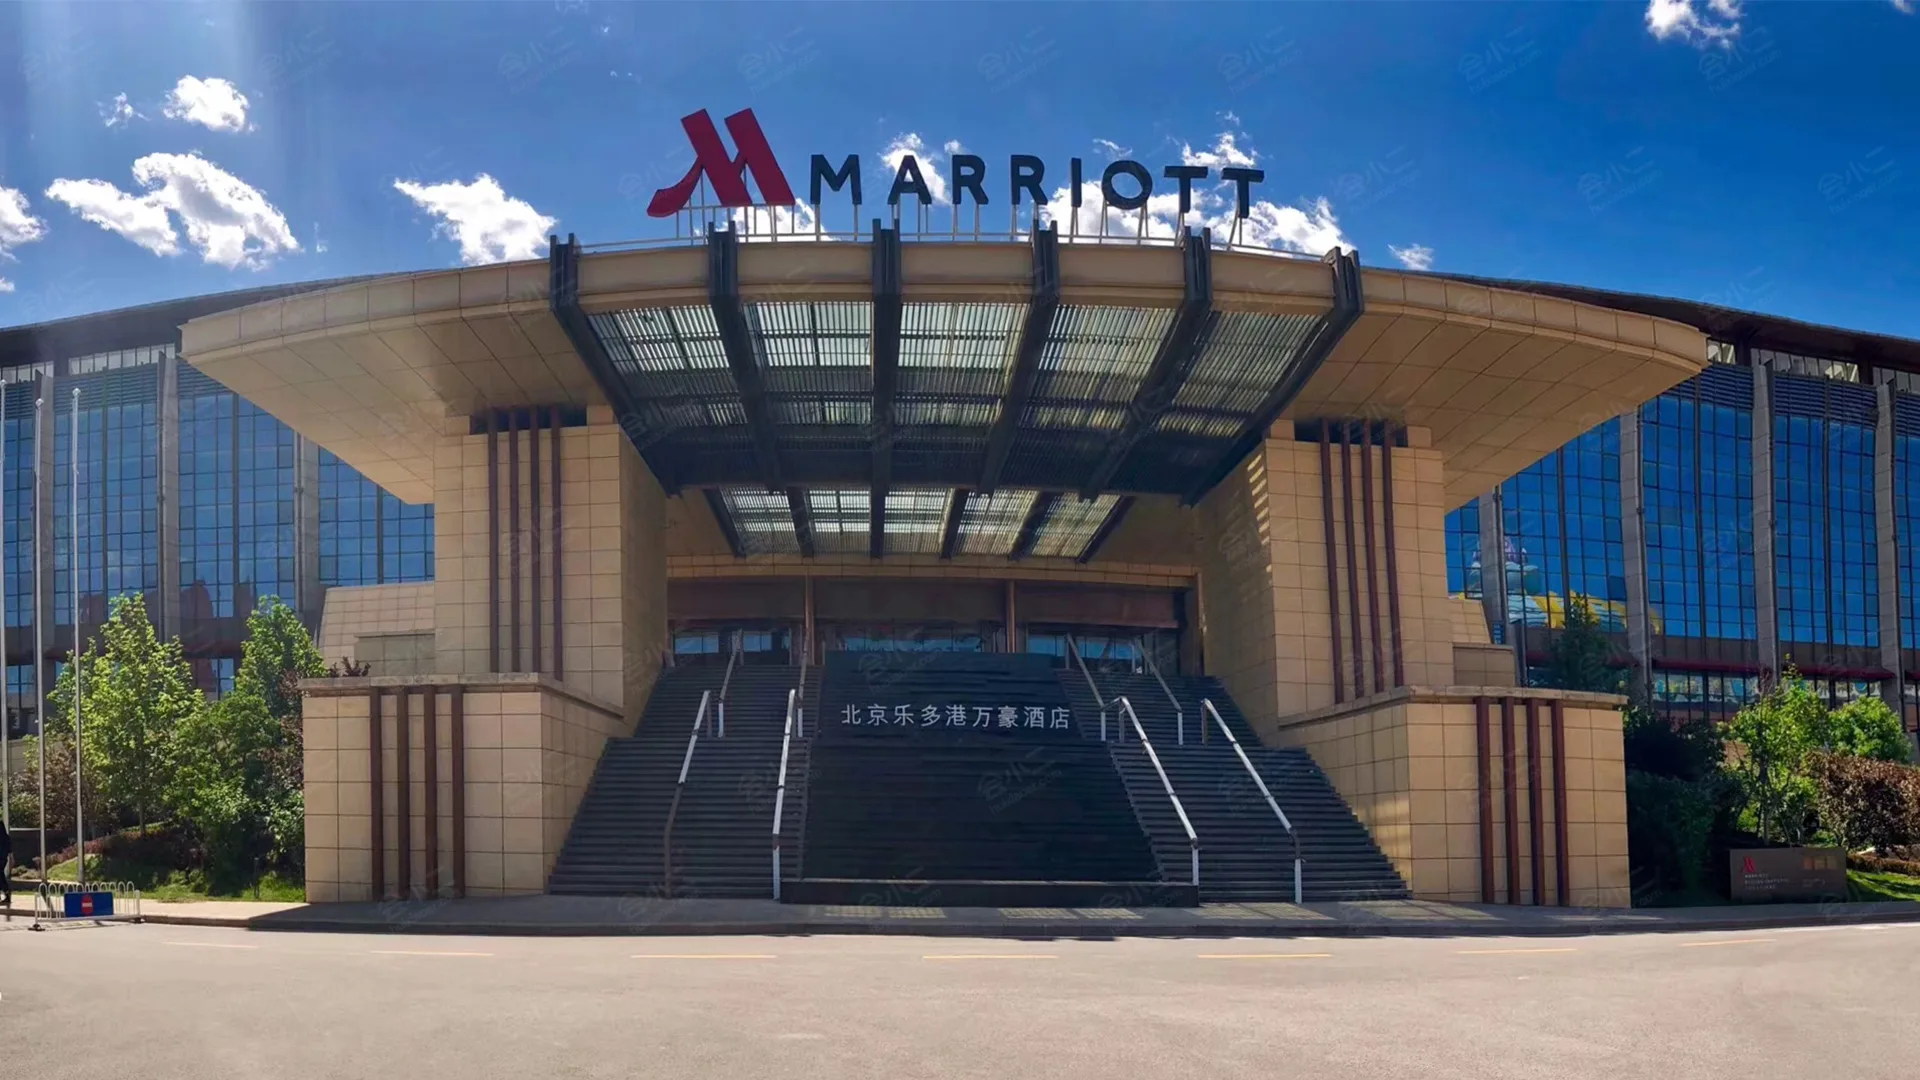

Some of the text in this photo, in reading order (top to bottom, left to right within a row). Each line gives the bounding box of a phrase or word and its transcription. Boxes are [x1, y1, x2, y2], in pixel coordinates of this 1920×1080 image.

[811, 154, 1265, 219] MARRIOTT
[841, 703, 1070, 729] 北京乐多港万豪酒店
